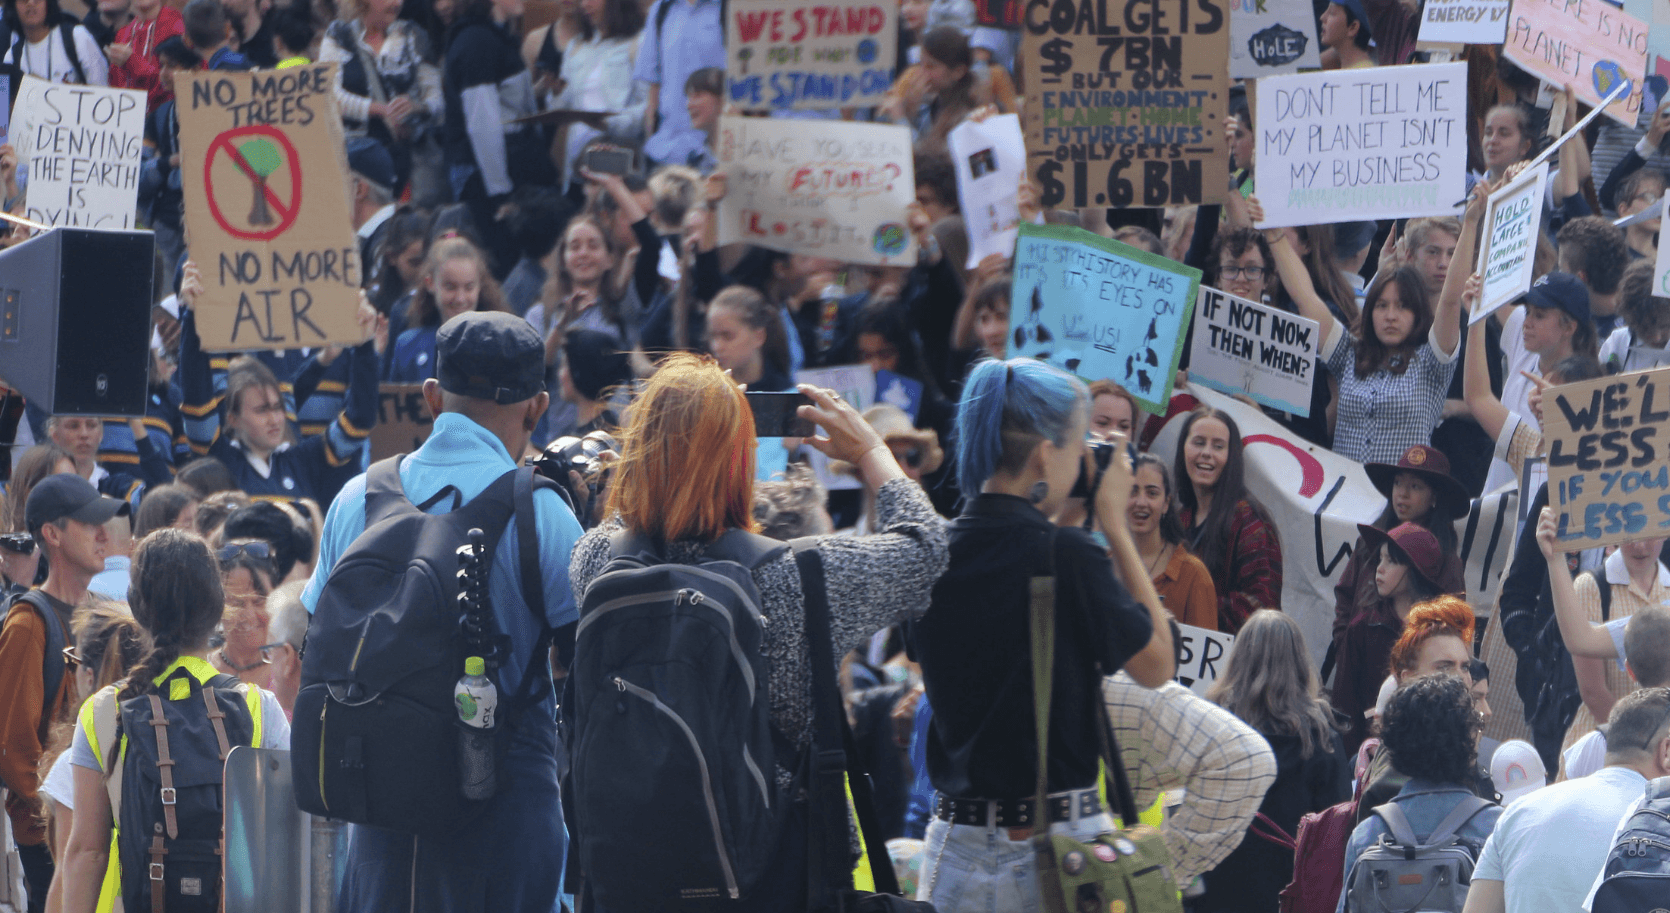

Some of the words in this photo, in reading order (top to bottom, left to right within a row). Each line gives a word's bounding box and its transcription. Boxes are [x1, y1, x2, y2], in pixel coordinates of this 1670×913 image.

[735, 9, 785, 43] WE
[788, 5, 887, 43] STAND
[1026, 0, 1121, 36] COAL
[1124, 0, 1224, 35] GETS
[1427, 6, 1488, 24] ENERGY
[1490, 6, 1507, 22] BY
[1598, 10, 1611, 37] IS
[1618, 22, 1649, 56] NO
[1513, 16, 1585, 78] PLANET
[191, 80, 236, 109] NO
[252, 67, 331, 97] MORE
[1043, 90, 1209, 108] ENVIRONMENT
[1072, 71, 1122, 89] BUT
[1132, 70, 1184, 90] OUR
[1626, 78, 1643, 113] B
[44, 87, 136, 127] STOP
[227, 94, 315, 128] TREES
[1043, 107, 1132, 127] PLANET
[1140, 107, 1203, 126] HOME
[1275, 82, 1341, 122] DON'T
[1352, 82, 1406, 116] TELL
[1416, 80, 1450, 113] ME
[36, 124, 141, 162] DENYING
[1043, 126, 1139, 145] FUTURES
[1144, 126, 1204, 145] LIVES
[1055, 143, 1116, 161] ONLY
[1118, 143, 1182, 160] GETS
[1264, 127, 1296, 156] MY
[1308, 121, 1389, 154] PLANET
[1400, 116, 1455, 148] ISN'T
[31, 155, 66, 181] THE
[70, 158, 137, 190] EARTH
[1143, 160, 1202, 205] BN
[1290, 160, 1321, 189] MY
[1332, 152, 1441, 187] BUSINESS
[68, 186, 86, 209] IS
[1495, 196, 1530, 228] HOLD
[219, 252, 261, 286] NO
[273, 250, 359, 288] MORE
[1147, 271, 1174, 295] HAS
[230, 287, 327, 343] AIR
[1099, 280, 1143, 309] EYES
[1153, 298, 1176, 316] ON
[1202, 290, 1224, 321] IF
[1228, 299, 1267, 336] NOT
[1270, 314, 1312, 353] NOW,
[1208, 323, 1254, 361] THEN
[1259, 340, 1311, 379] WHEN?
[1555, 374, 1670, 432] WE'L
[1549, 426, 1657, 471] LESS
[1559, 474, 1585, 505] IF
[1599, 464, 1669, 497] YOU
[1556, 502, 1648, 542] LESS
